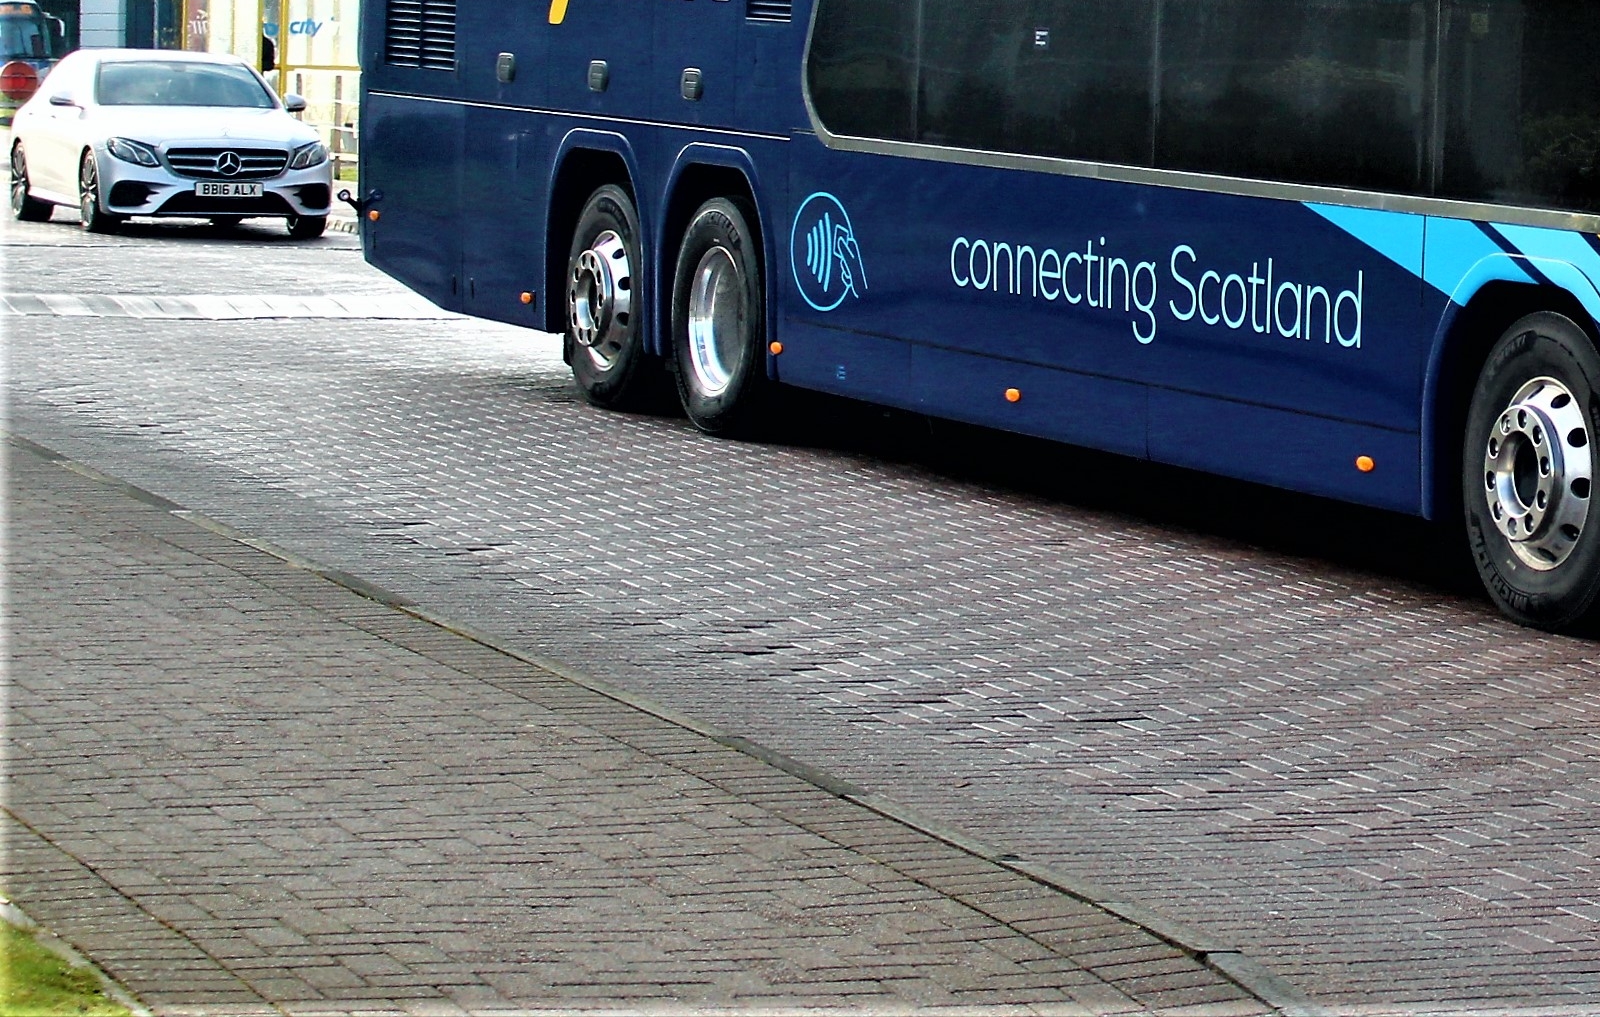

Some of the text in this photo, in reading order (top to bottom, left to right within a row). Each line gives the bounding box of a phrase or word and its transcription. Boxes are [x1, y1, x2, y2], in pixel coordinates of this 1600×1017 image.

[203, 184, 256, 195] BB16 ALX
[950, 236, 1363, 349] connecting Scotland
